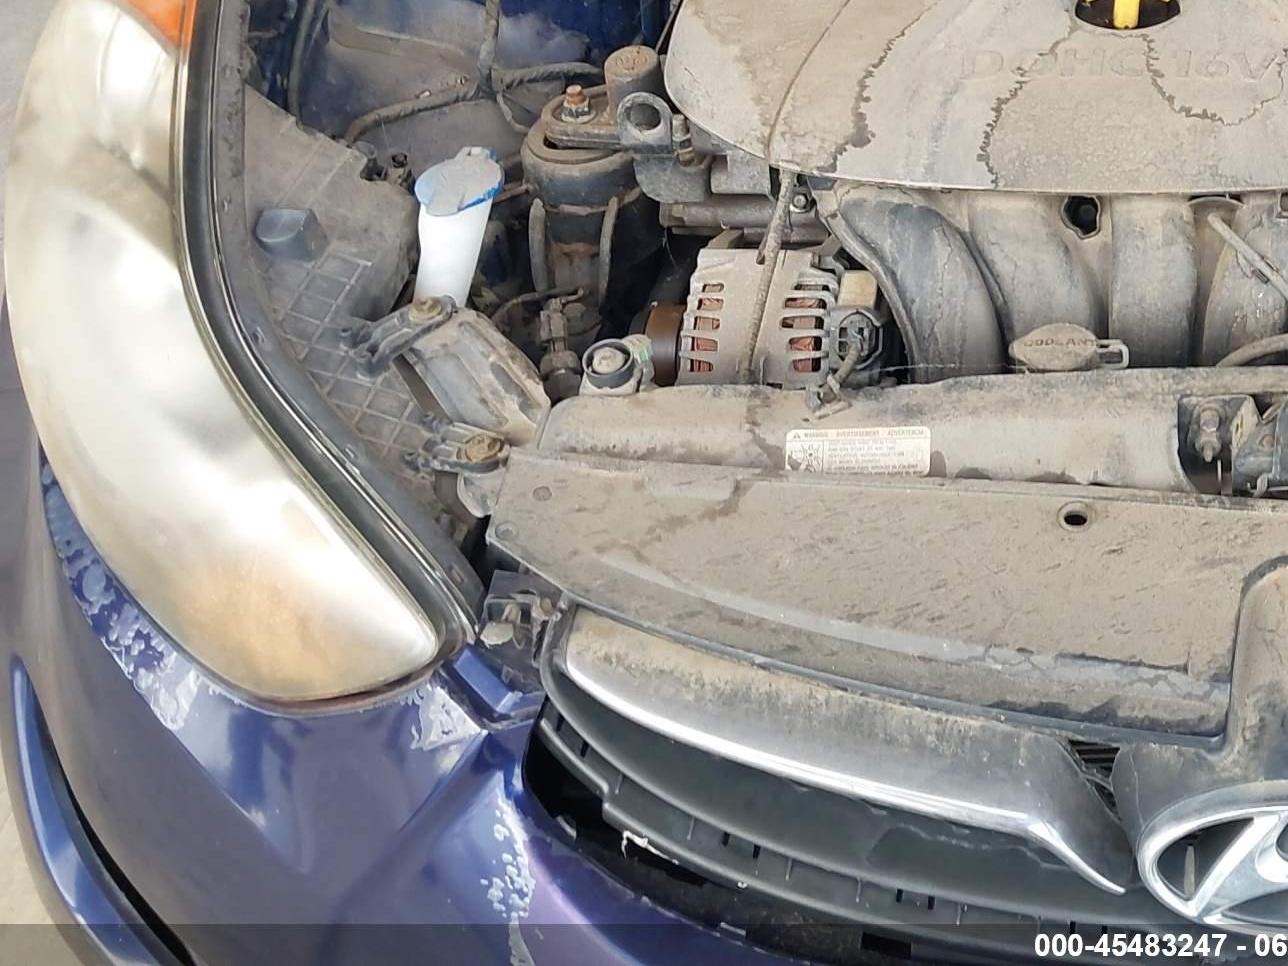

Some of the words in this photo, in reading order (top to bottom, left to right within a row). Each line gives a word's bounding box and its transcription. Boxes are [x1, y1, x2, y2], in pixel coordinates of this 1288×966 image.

[960, 48, 1147, 80] DOHC
[1172, 48, 1281, 82] 16V
[1023, 337, 1098, 347] COOLANT
